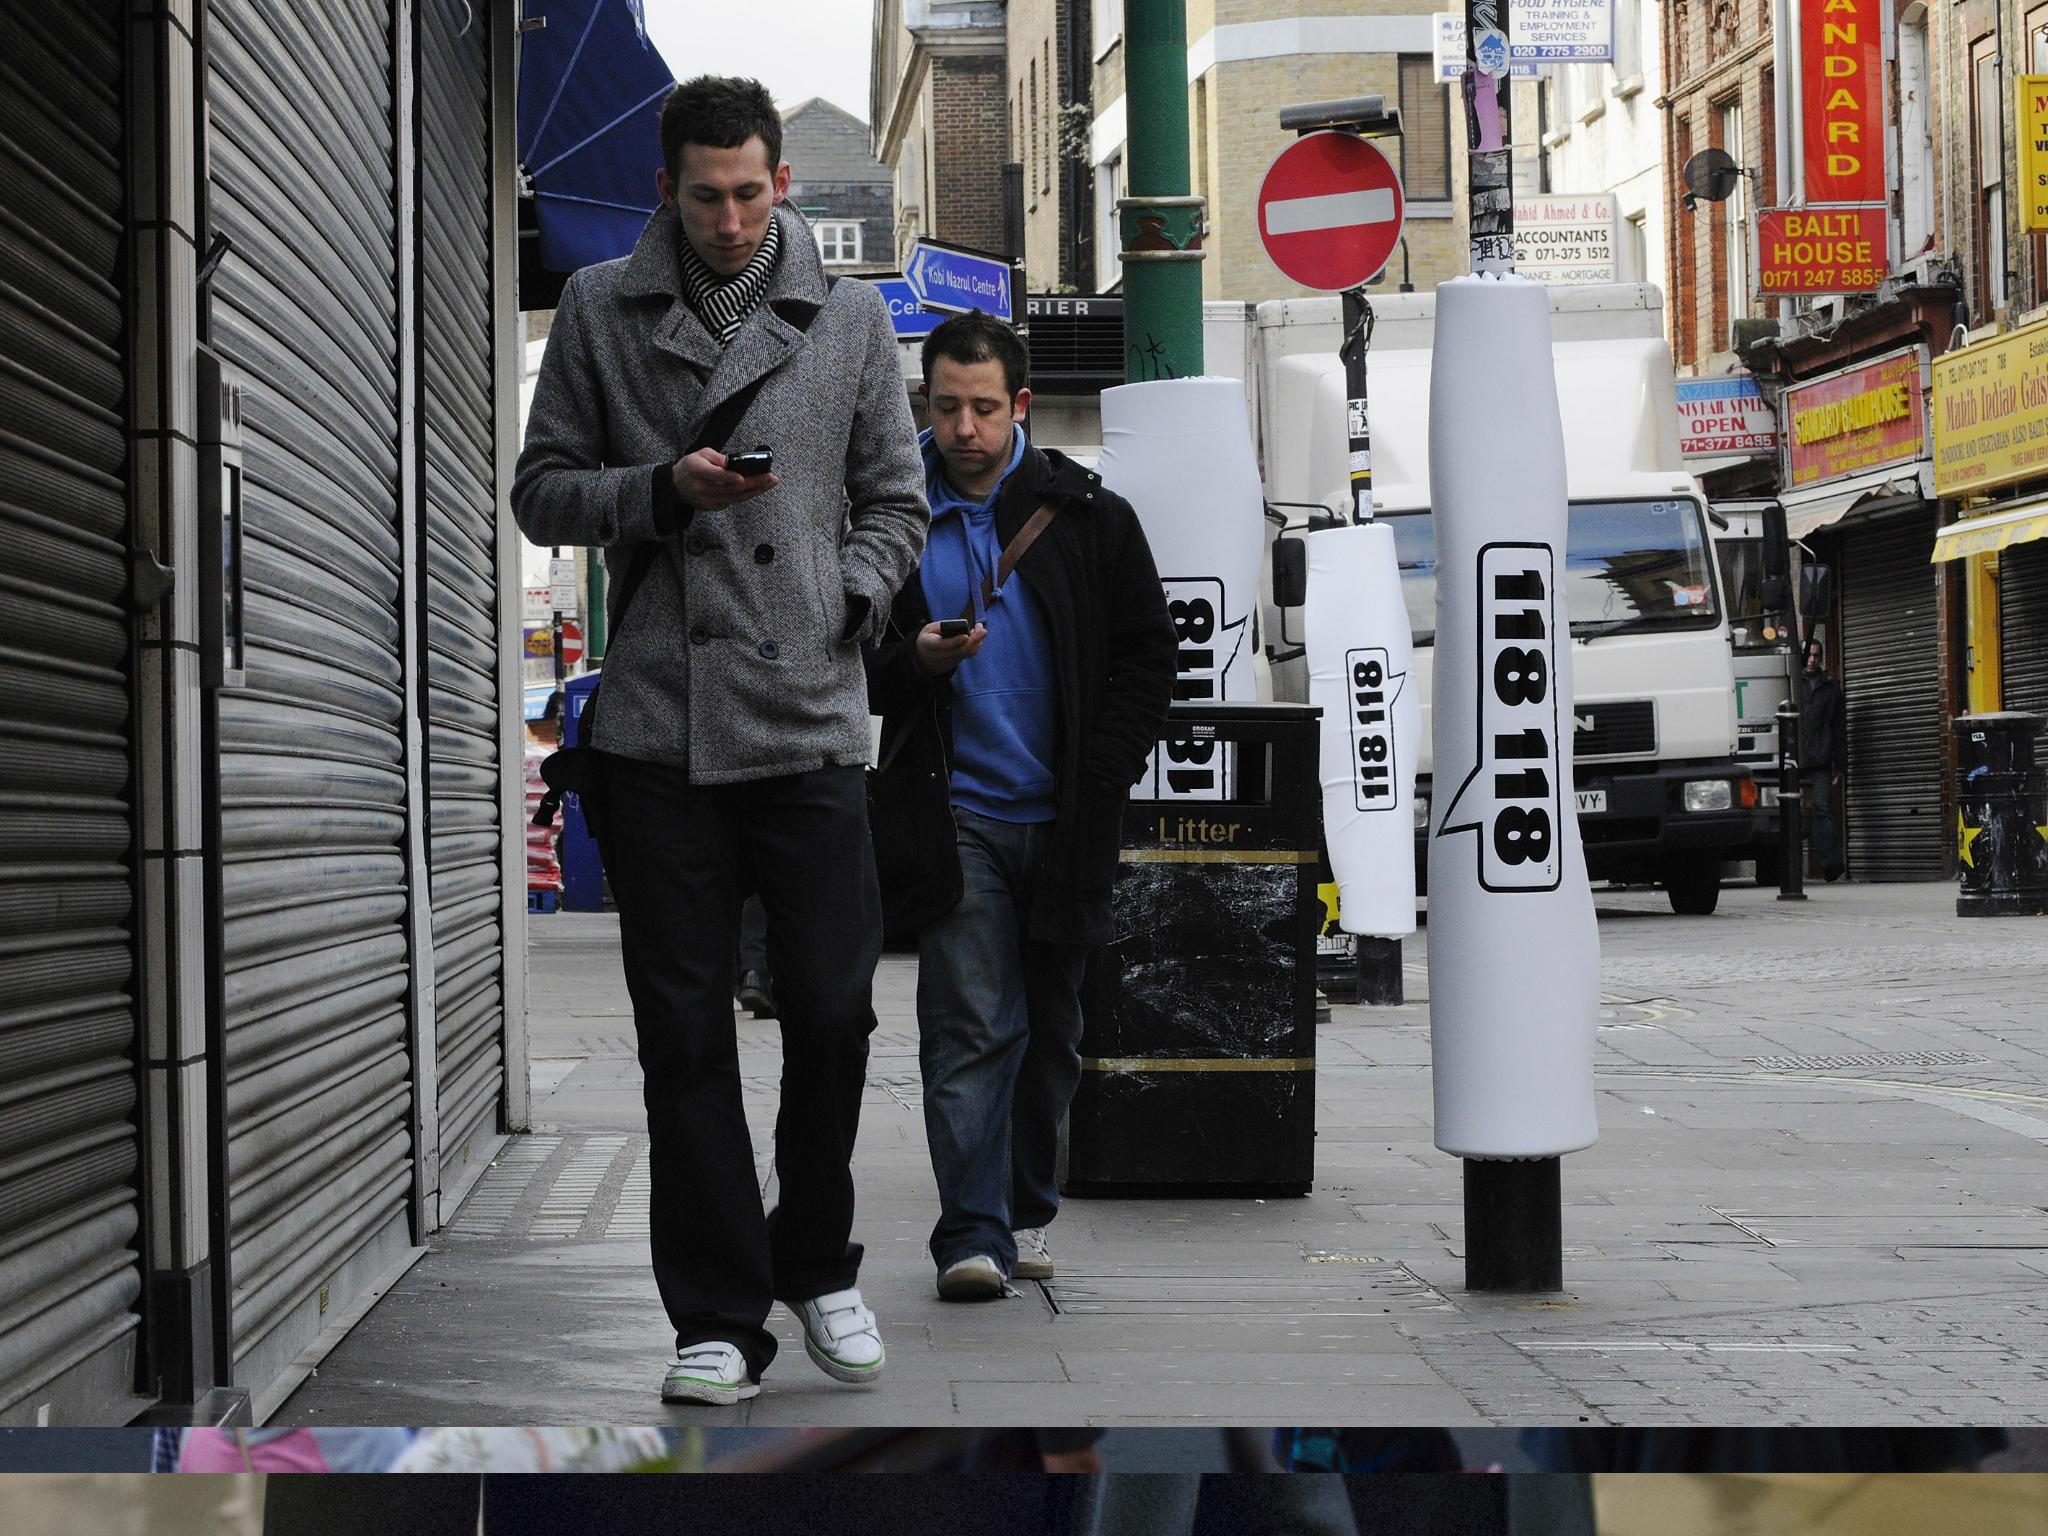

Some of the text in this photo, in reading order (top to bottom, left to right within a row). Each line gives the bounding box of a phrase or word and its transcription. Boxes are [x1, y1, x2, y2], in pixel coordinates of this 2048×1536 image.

[1526, 11, 1591, 19] TRAINING &
[1520, 21, 1597, 31] EMPLOYMENT
[1531, 32, 1587, 41] SERVICES
[1513, 45, 1605, 57] 020 7375 2900
[1544, 203, 1576, 220] Ahmed
[1582, 203, 1590, 218] &
[1595, 202, 1611, 218] Co.
[1784, 214, 1860, 238] BALTI
[1515, 229, 1608, 245] ACCOUNTANTS
[1535, 247, 1610, 260] 071-375 1512
[1773, 241, 1872, 265] HOUSE
[928, 266, 996, 297] Kobi Nazrul Centre
[1562, 269, 1611, 280] MORTGAGE
[1762, 267, 1884, 288] 0171 247 5855
[1980, 379, 2017, 424] Indian
[1794, 403, 1840, 447] STANDARD
[1841, 388, 1870, 433] BALTI
[1870, 380, 1911, 424] HOUSE
[1691, 416, 1745, 434] OPEN
[1160, 816, 1240, 843] Litter
